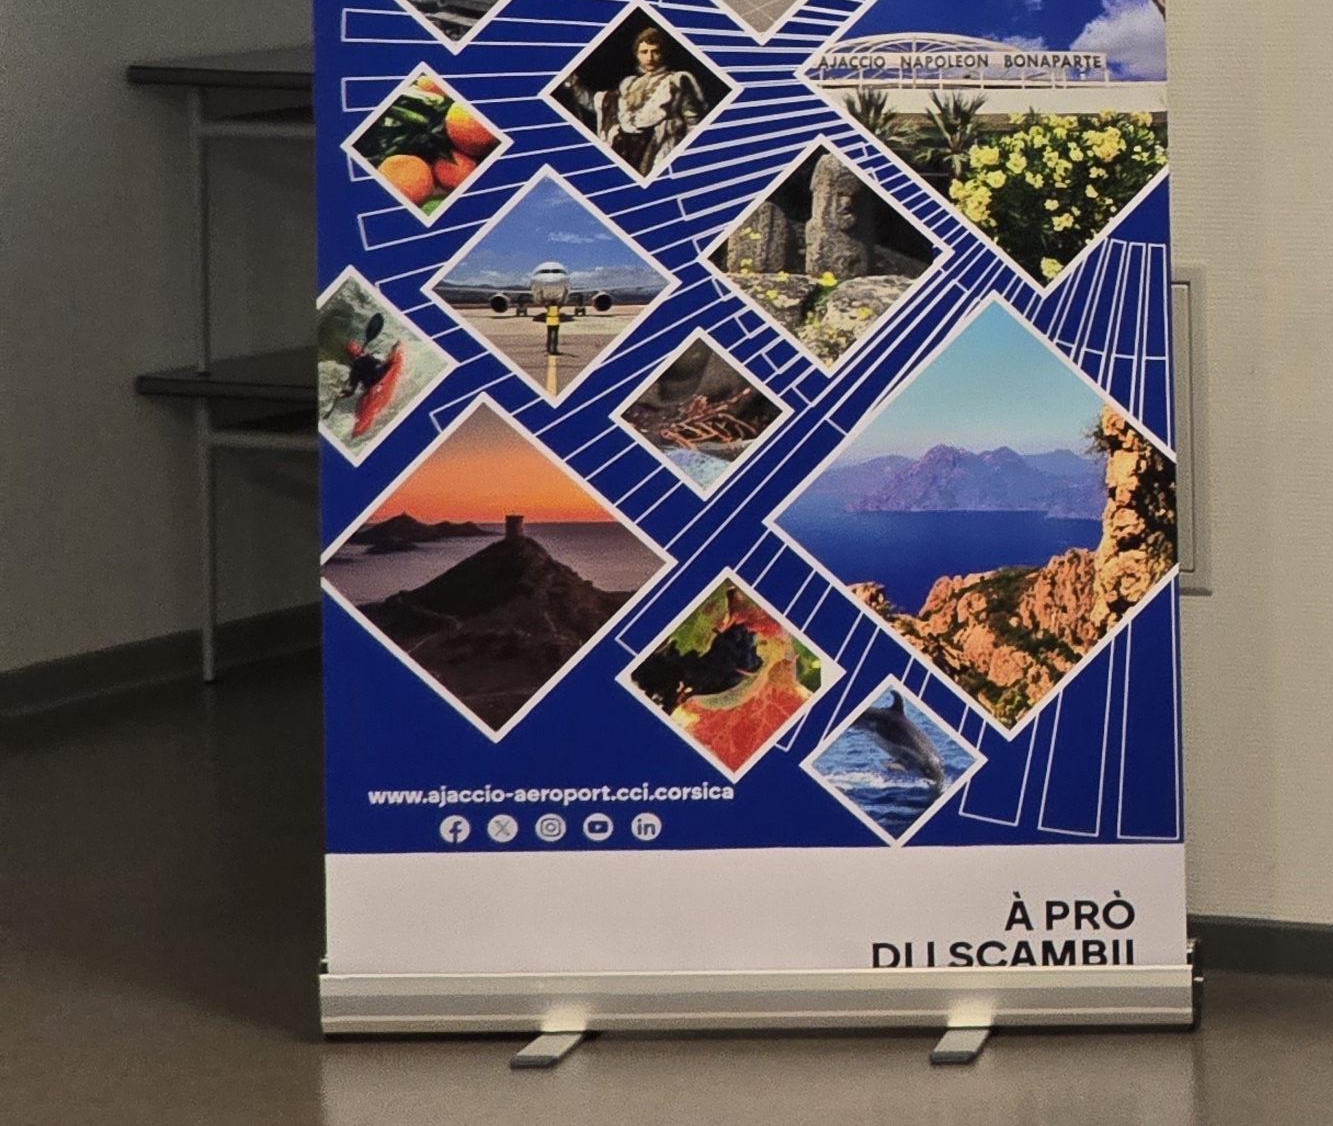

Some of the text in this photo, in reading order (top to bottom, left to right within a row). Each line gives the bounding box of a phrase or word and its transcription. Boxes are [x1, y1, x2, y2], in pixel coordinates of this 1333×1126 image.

[818, 54, 1102, 69] AJACCIO NAPOLEON BONAPARTE
[368, 782, 734, 807] www.ajaccio-aeroport.cci.corsica
[1004, 890, 1136, 931] À PRÒ
